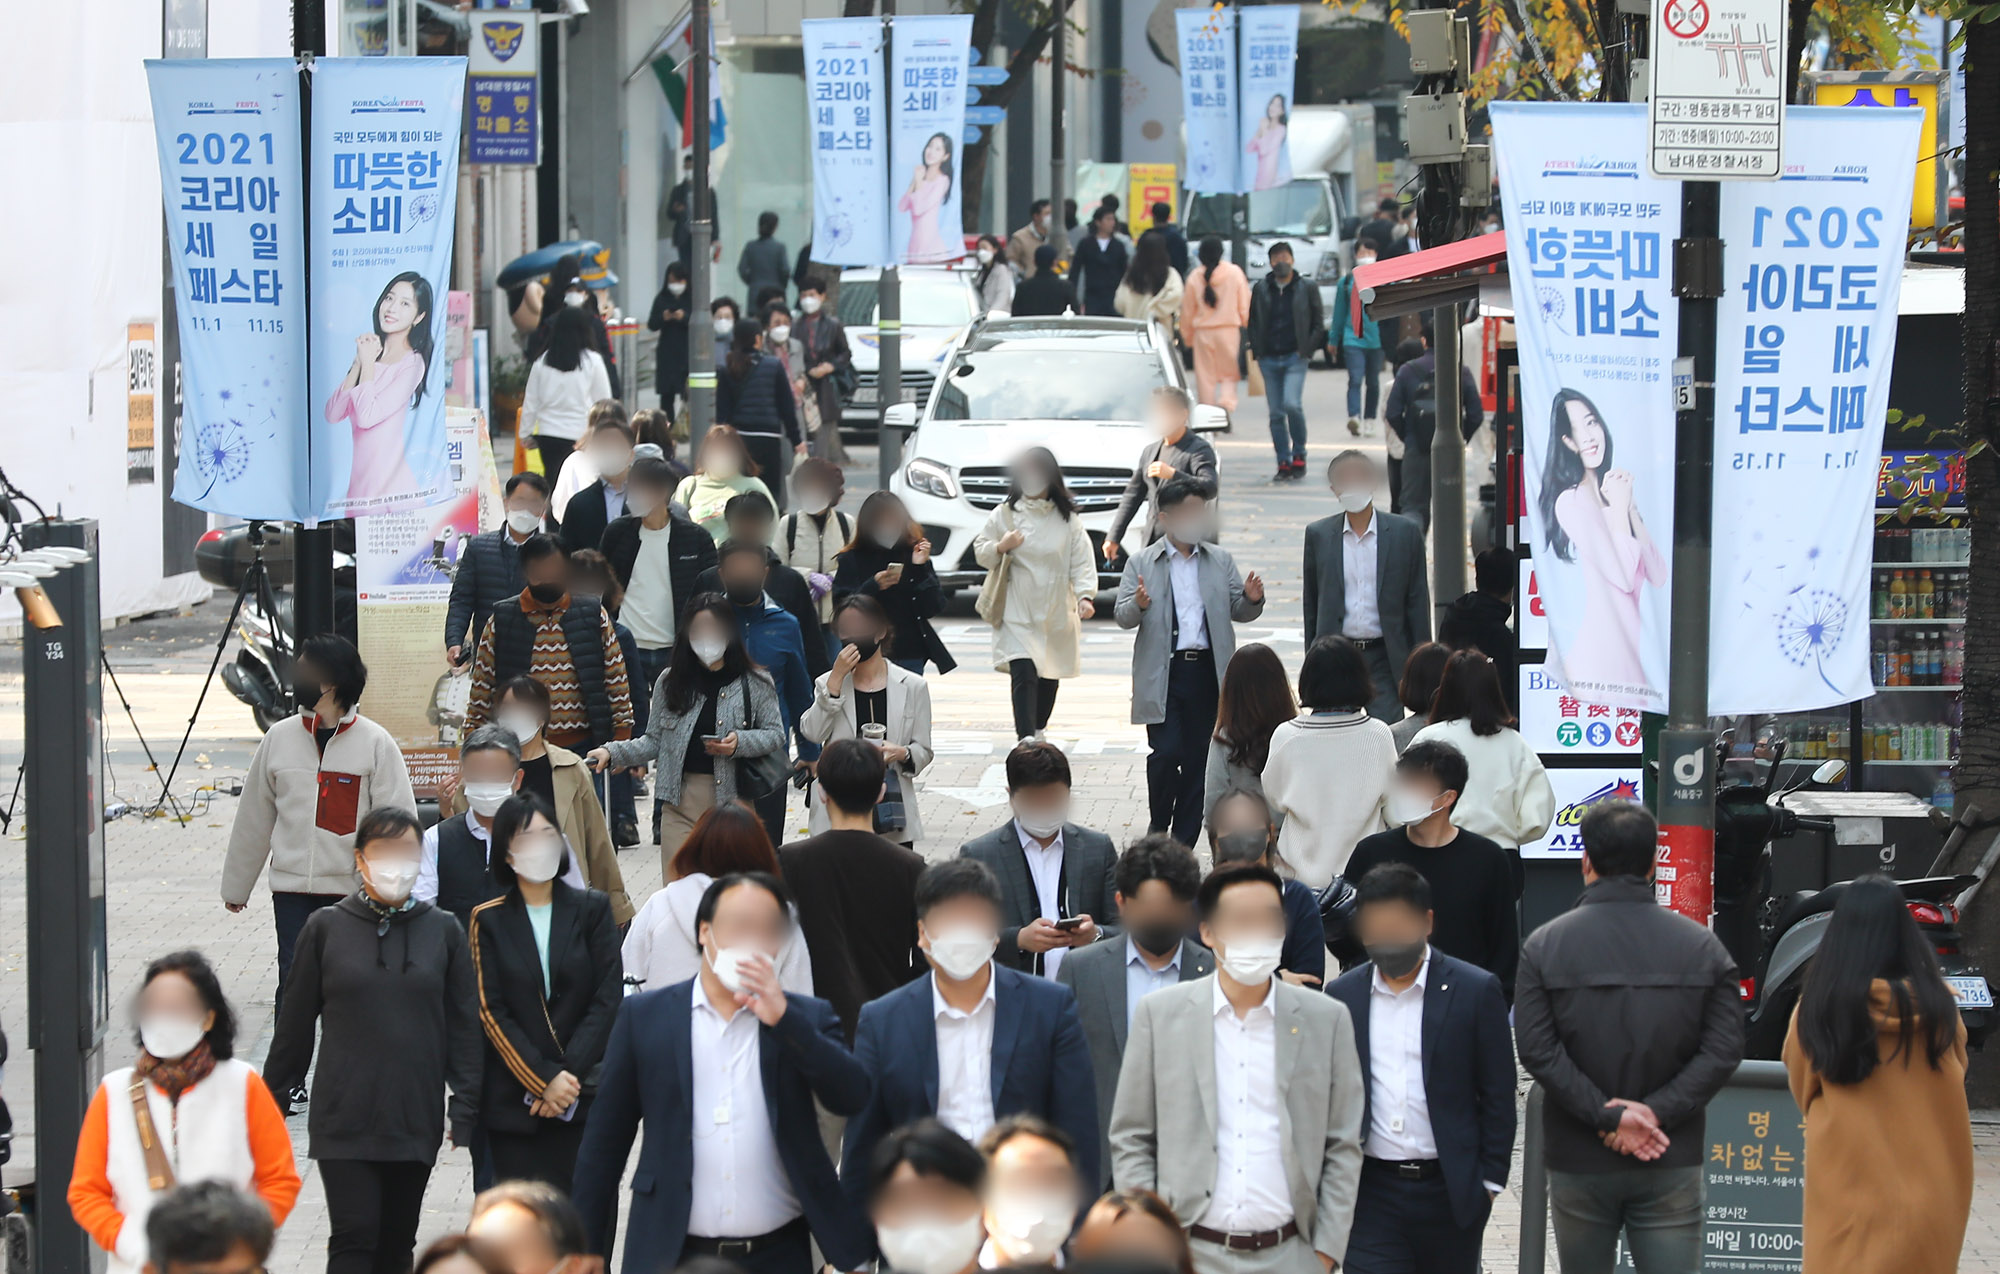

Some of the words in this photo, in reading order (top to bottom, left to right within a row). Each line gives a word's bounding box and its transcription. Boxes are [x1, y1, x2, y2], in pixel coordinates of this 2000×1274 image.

[1187, 38, 1224, 52] 2021
[815, 58, 869, 77] 2021
[1189, 56, 1226, 72] 코리아
[1250, 62, 1277, 79] 소비
[903, 66, 959, 89] 따뜻한
[815, 81, 871, 103] 코리아
[188, 101, 214, 109] KOREA
[235, 100, 259, 108] FESTA
[352, 100, 377, 108] KOREA
[400, 99, 424, 107] FESTA
[903, 91, 938, 112] 소비
[817, 106, 834, 127] 세
[854, 106, 871, 127] 일
[1755, 103, 1776, 119] 일대
[476, 116, 530, 134] 파출소
[333, 131, 354, 144] 국민
[356, 130, 398, 144] 모두에게
[400, 130, 421, 143] 힘이
[423, 129, 443, 142] 되는
[817, 130, 872, 152] 페스타
[176, 133, 274, 165] 2021
[1668, 154, 1764, 169] 남대문경찰서장
[334, 150, 442, 191] 따뜻한
[180, 175, 280, 214] 코리아
[332, 195, 402, 234] 소비
[184, 222, 215, 258] 세
[250, 222, 279, 260] 일
[190, 269, 283, 307] 페스타
[248, 319, 283, 334] 11.15
[46, 642, 62, 651] TG
[46, 651, 64, 660] Y34
[1673, 788, 1704, 800] 서울중구
[1709, 1174, 1733, 1185] 걸으면
[1772, 1176, 1797, 1188] 서울이
[1707, 1206, 1748, 1220] 운영시간
[1706, 1230, 1741, 1252] 매일
